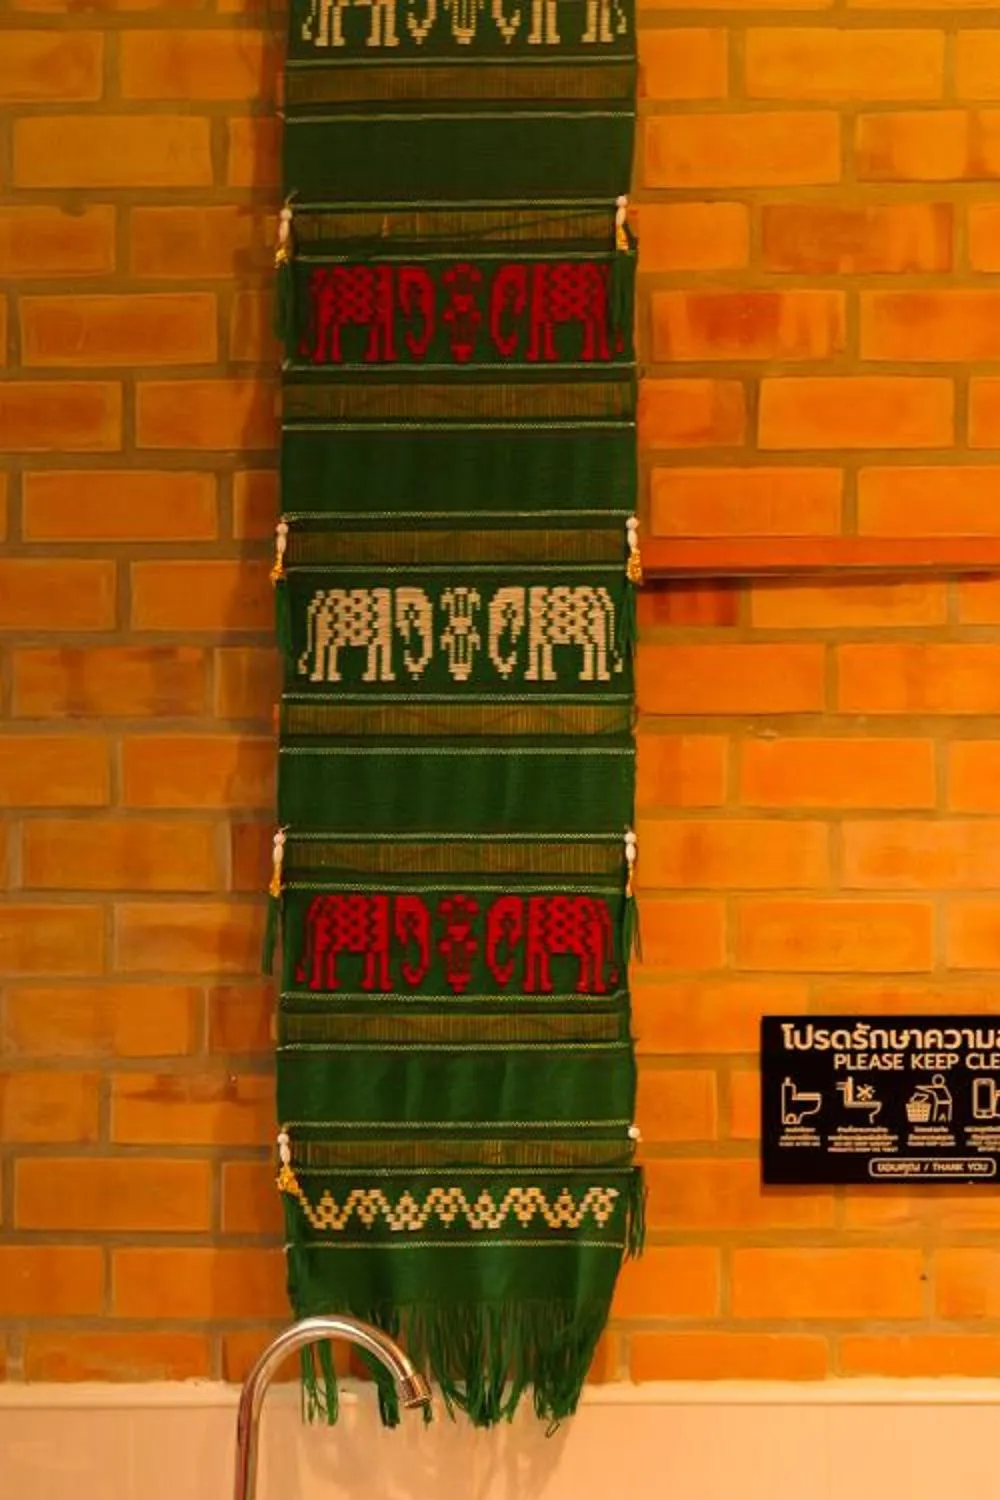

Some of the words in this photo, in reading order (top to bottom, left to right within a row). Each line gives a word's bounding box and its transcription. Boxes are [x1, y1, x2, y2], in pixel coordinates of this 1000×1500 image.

[833, 1053, 904, 1071] PLEASE
[911, 1053, 959, 1070] KEEP
[932, 1162, 964, 1172] THANK
[967, 1163, 988, 1172] YOU
